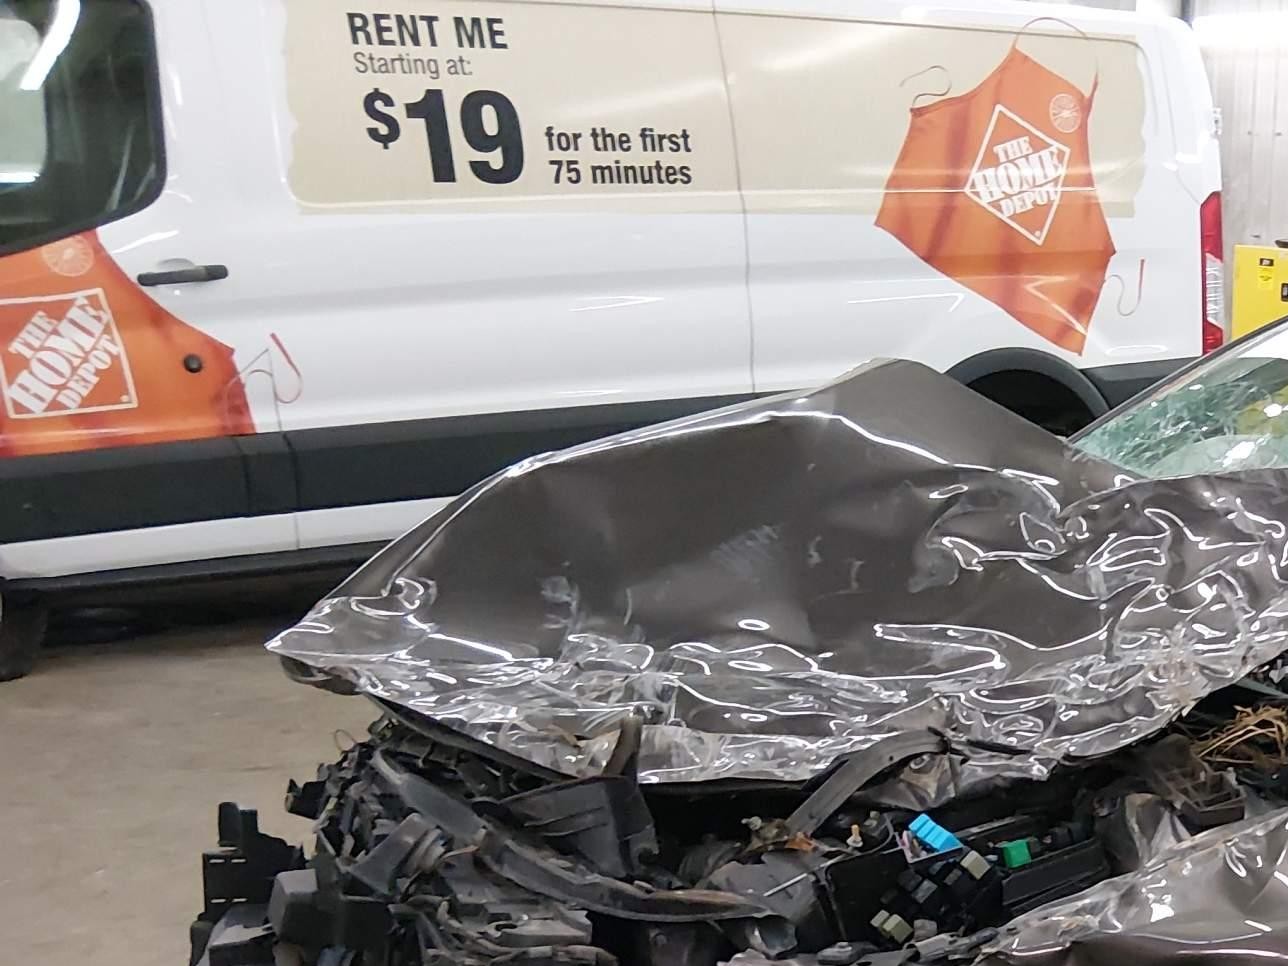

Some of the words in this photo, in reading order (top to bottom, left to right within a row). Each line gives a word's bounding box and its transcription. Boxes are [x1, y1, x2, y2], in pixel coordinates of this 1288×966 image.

[346, 12, 439, 48] RENT
[453, 16, 508, 49] ME
[353, 52, 440, 80] Starting
[446, 56, 473, 76] at:
[363, 87, 524, 185] $19
[545, 126, 582, 152] for
[590, 127, 632, 153] the
[639, 127, 692, 153] first
[993, 136, 1033, 163] THE
[548, 159, 581, 185] 75
[590, 159, 692, 185] minutes
[974, 146, 1063, 203] HOME
[999, 181, 1059, 218] DEPOT
[8, 310, 58, 359] THE
[7, 296, 109, 414] HOME
[56, 334, 120, 410] DEPOT
